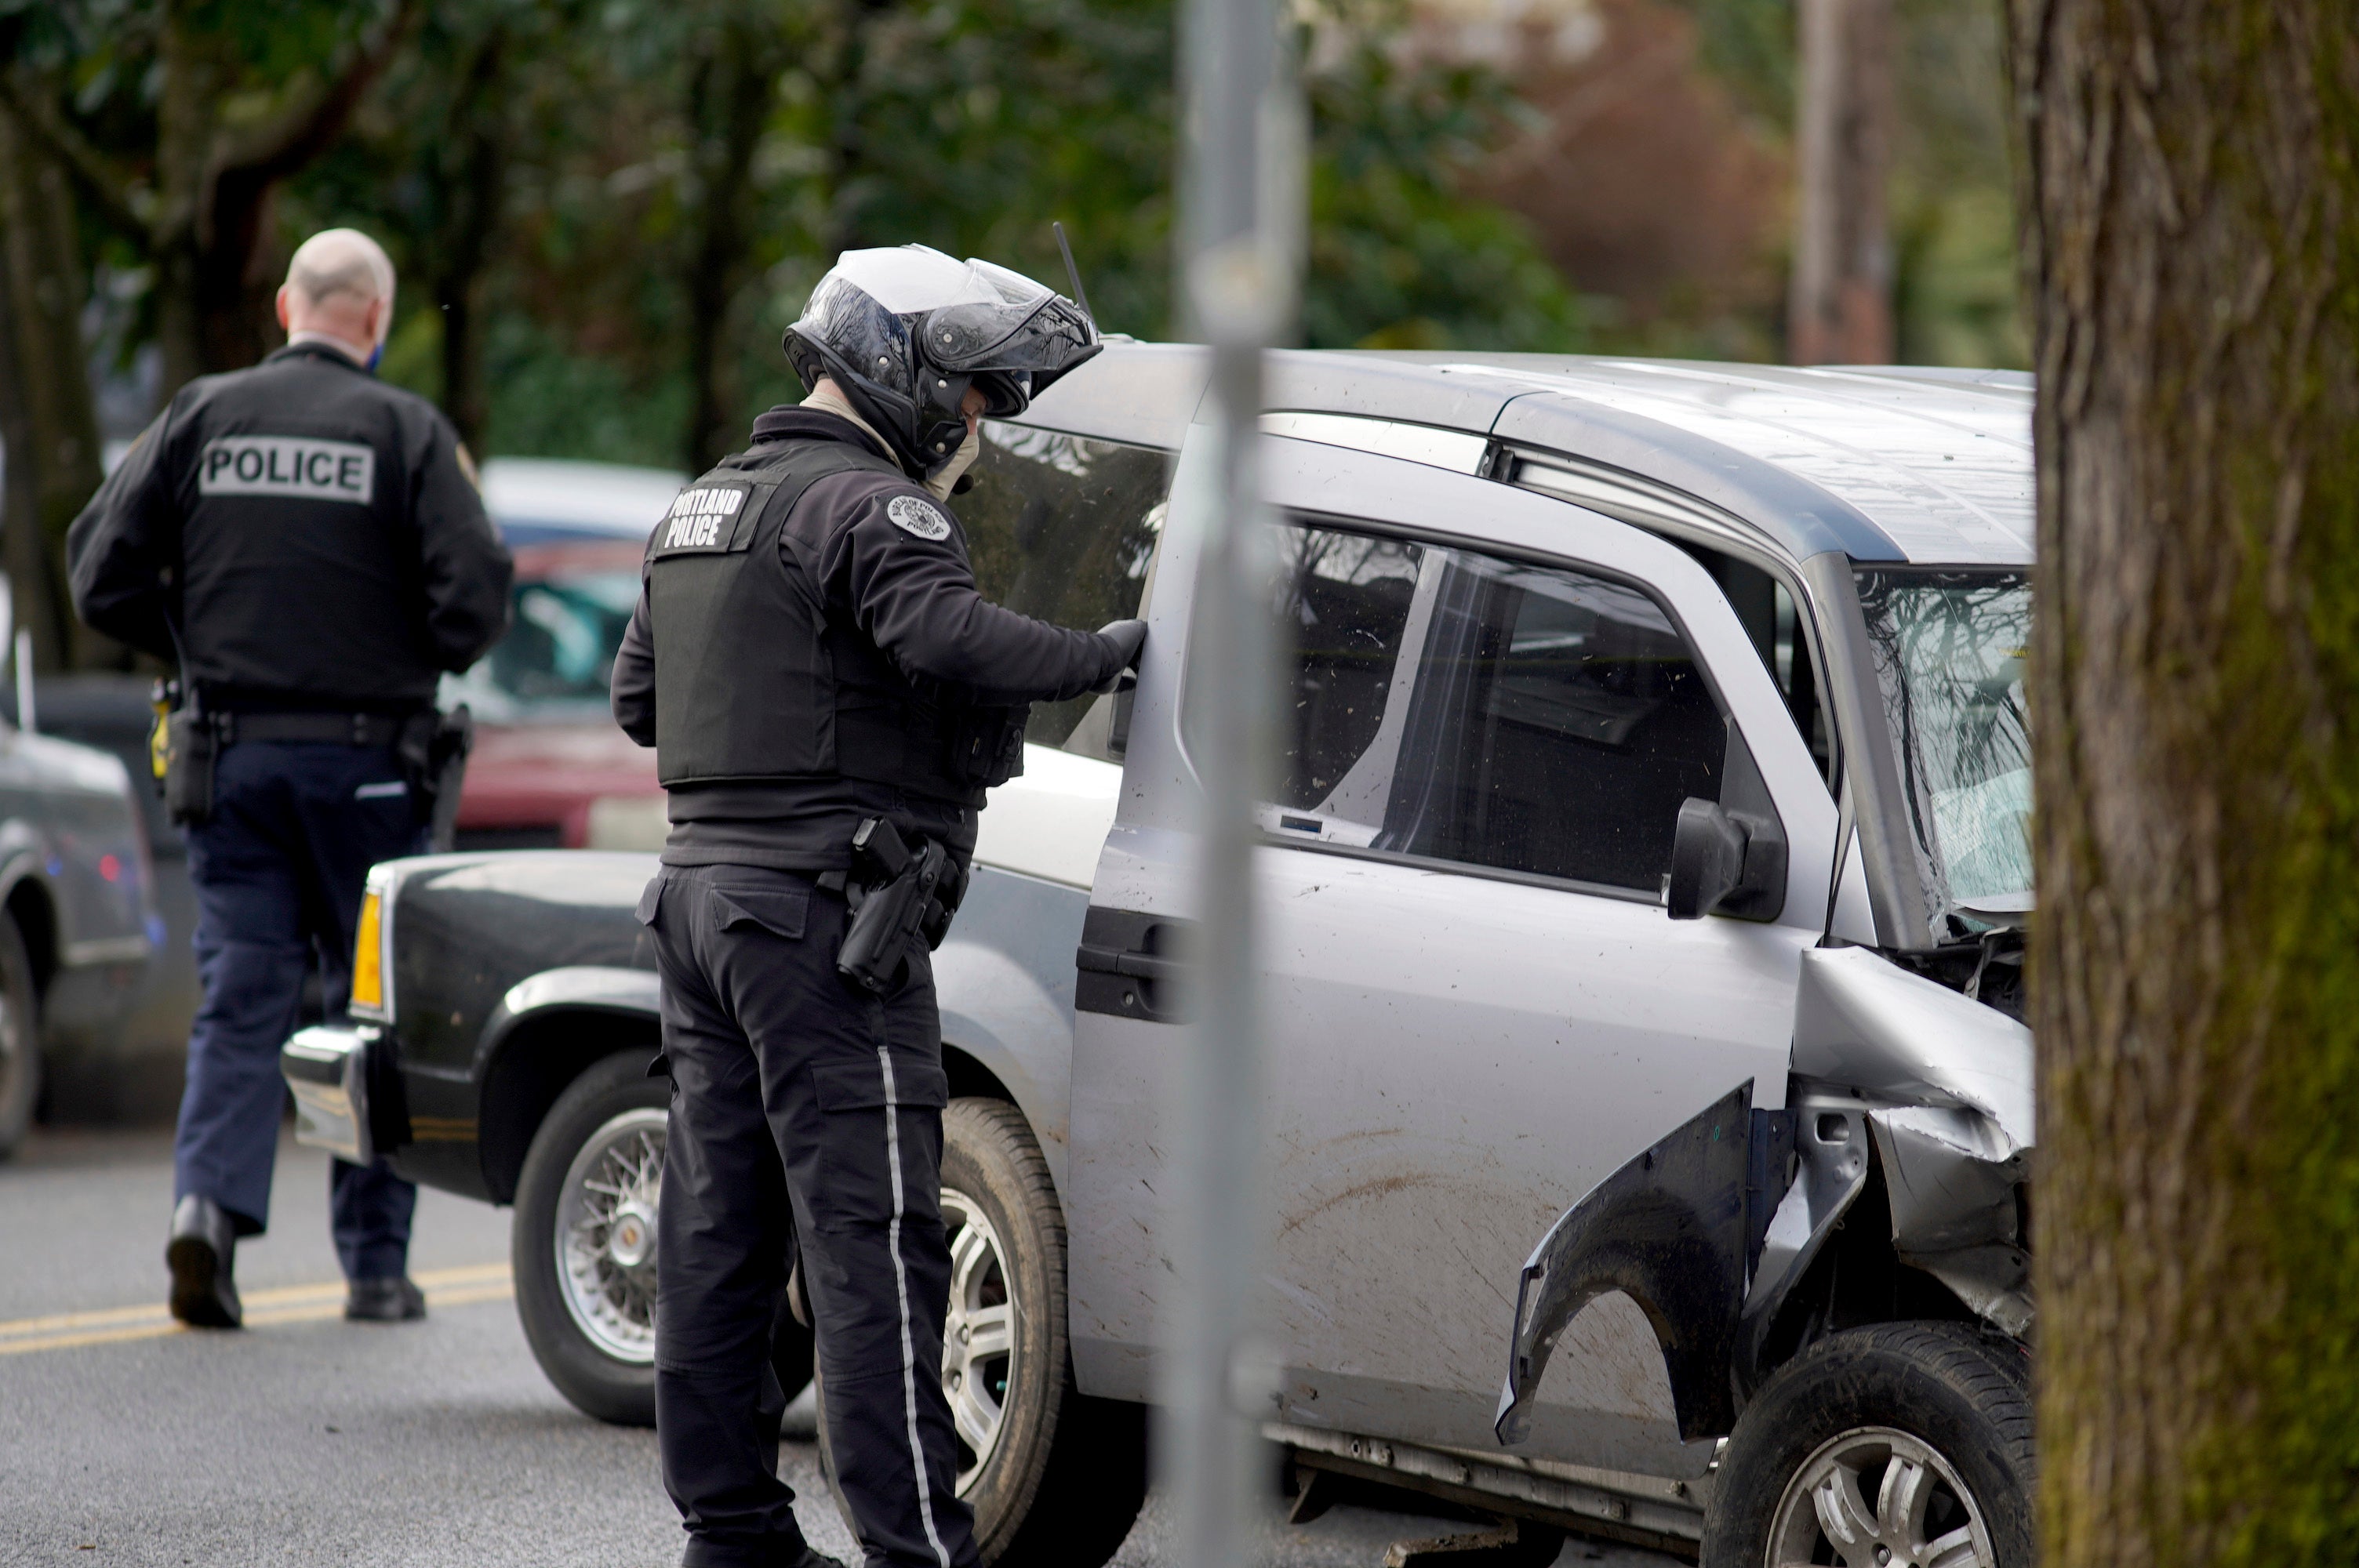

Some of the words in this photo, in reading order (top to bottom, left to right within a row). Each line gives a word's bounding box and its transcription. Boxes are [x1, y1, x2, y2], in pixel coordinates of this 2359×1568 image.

[207, 447, 364, 492] POLICE
[668, 488, 743, 518] PORTLAND
[664, 514, 722, 549] POLICE
